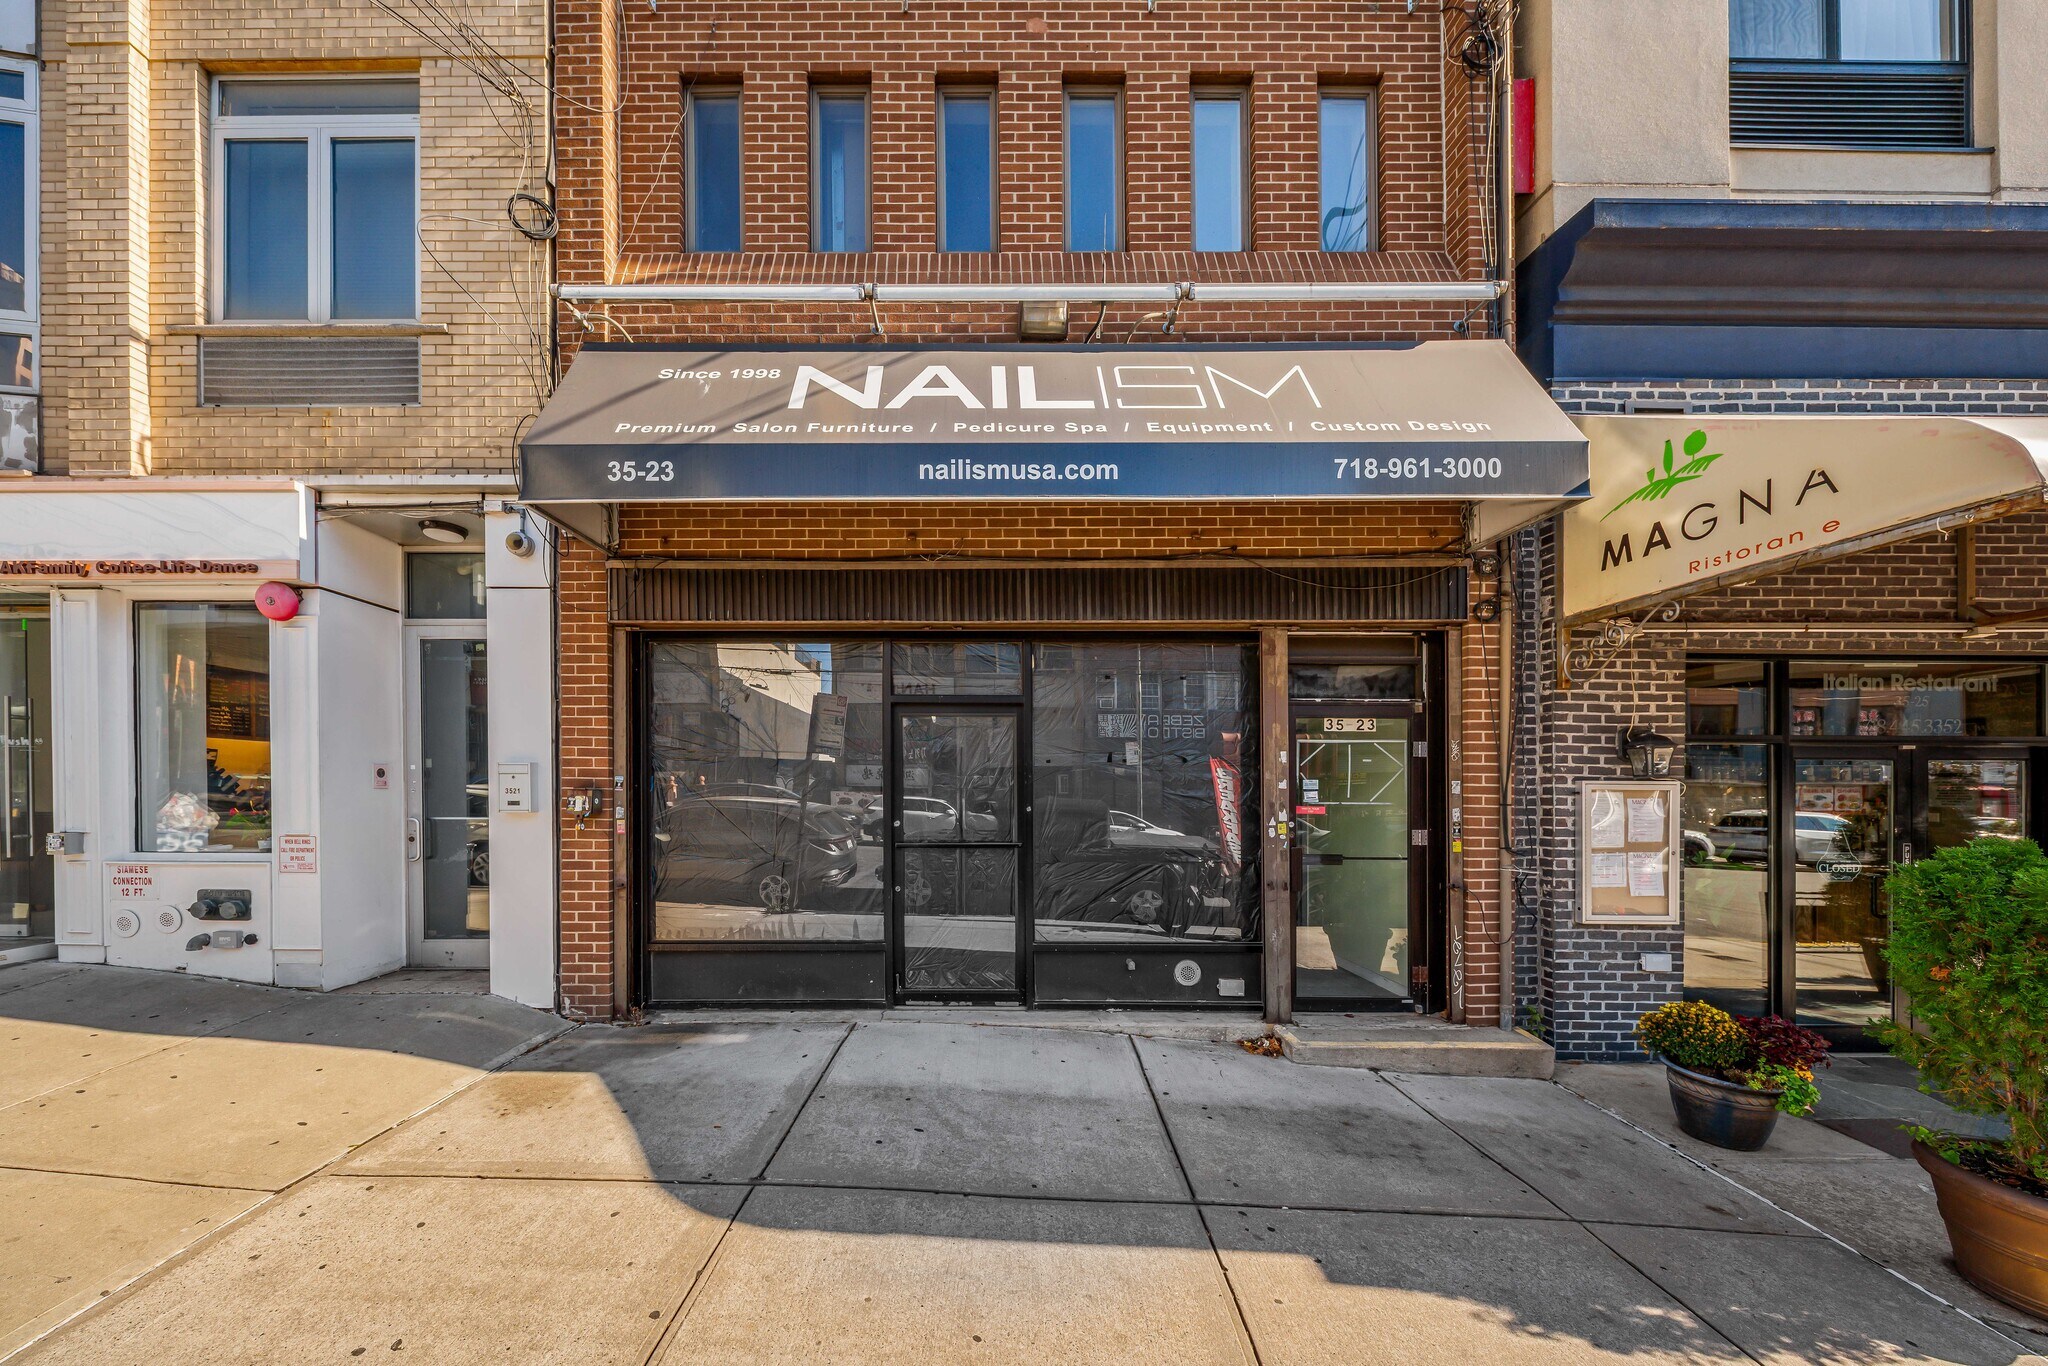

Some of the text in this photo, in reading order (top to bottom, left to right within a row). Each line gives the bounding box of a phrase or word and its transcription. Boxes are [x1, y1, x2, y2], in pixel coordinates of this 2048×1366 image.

[658, 368, 781, 379] Since 1998
[787, 365, 1322, 409] NAILISM
[615, 423, 716, 433] Premium
[733, 423, 797, 433] Salon
[807, 422, 913, 433] Furniture
[954, 422, 1055, 433] Pedicure
[1064, 422, 1108, 434] Spa
[1146, 421, 1273, 434] Equipment
[1310, 421, 1401, 431] Custom
[1408, 420, 1492, 433] Design
[607, 460, 675, 482] 35-23
[919, 459, 1119, 480] nailismusa.com
[1334, 457, 1502, 479] 718-961-3000
[1601, 469, 1839, 571] MAGNA
[1823, 673, 1999, 692] Italian Restaurant
[504, 787, 521, 795] 3521
[117, 865, 149, 874] SIAMESE
[1819, 863, 1860, 873] CLOSED
[112, 877, 153, 886] CONNECTION
[121, 888, 146, 897] 12 FT.
